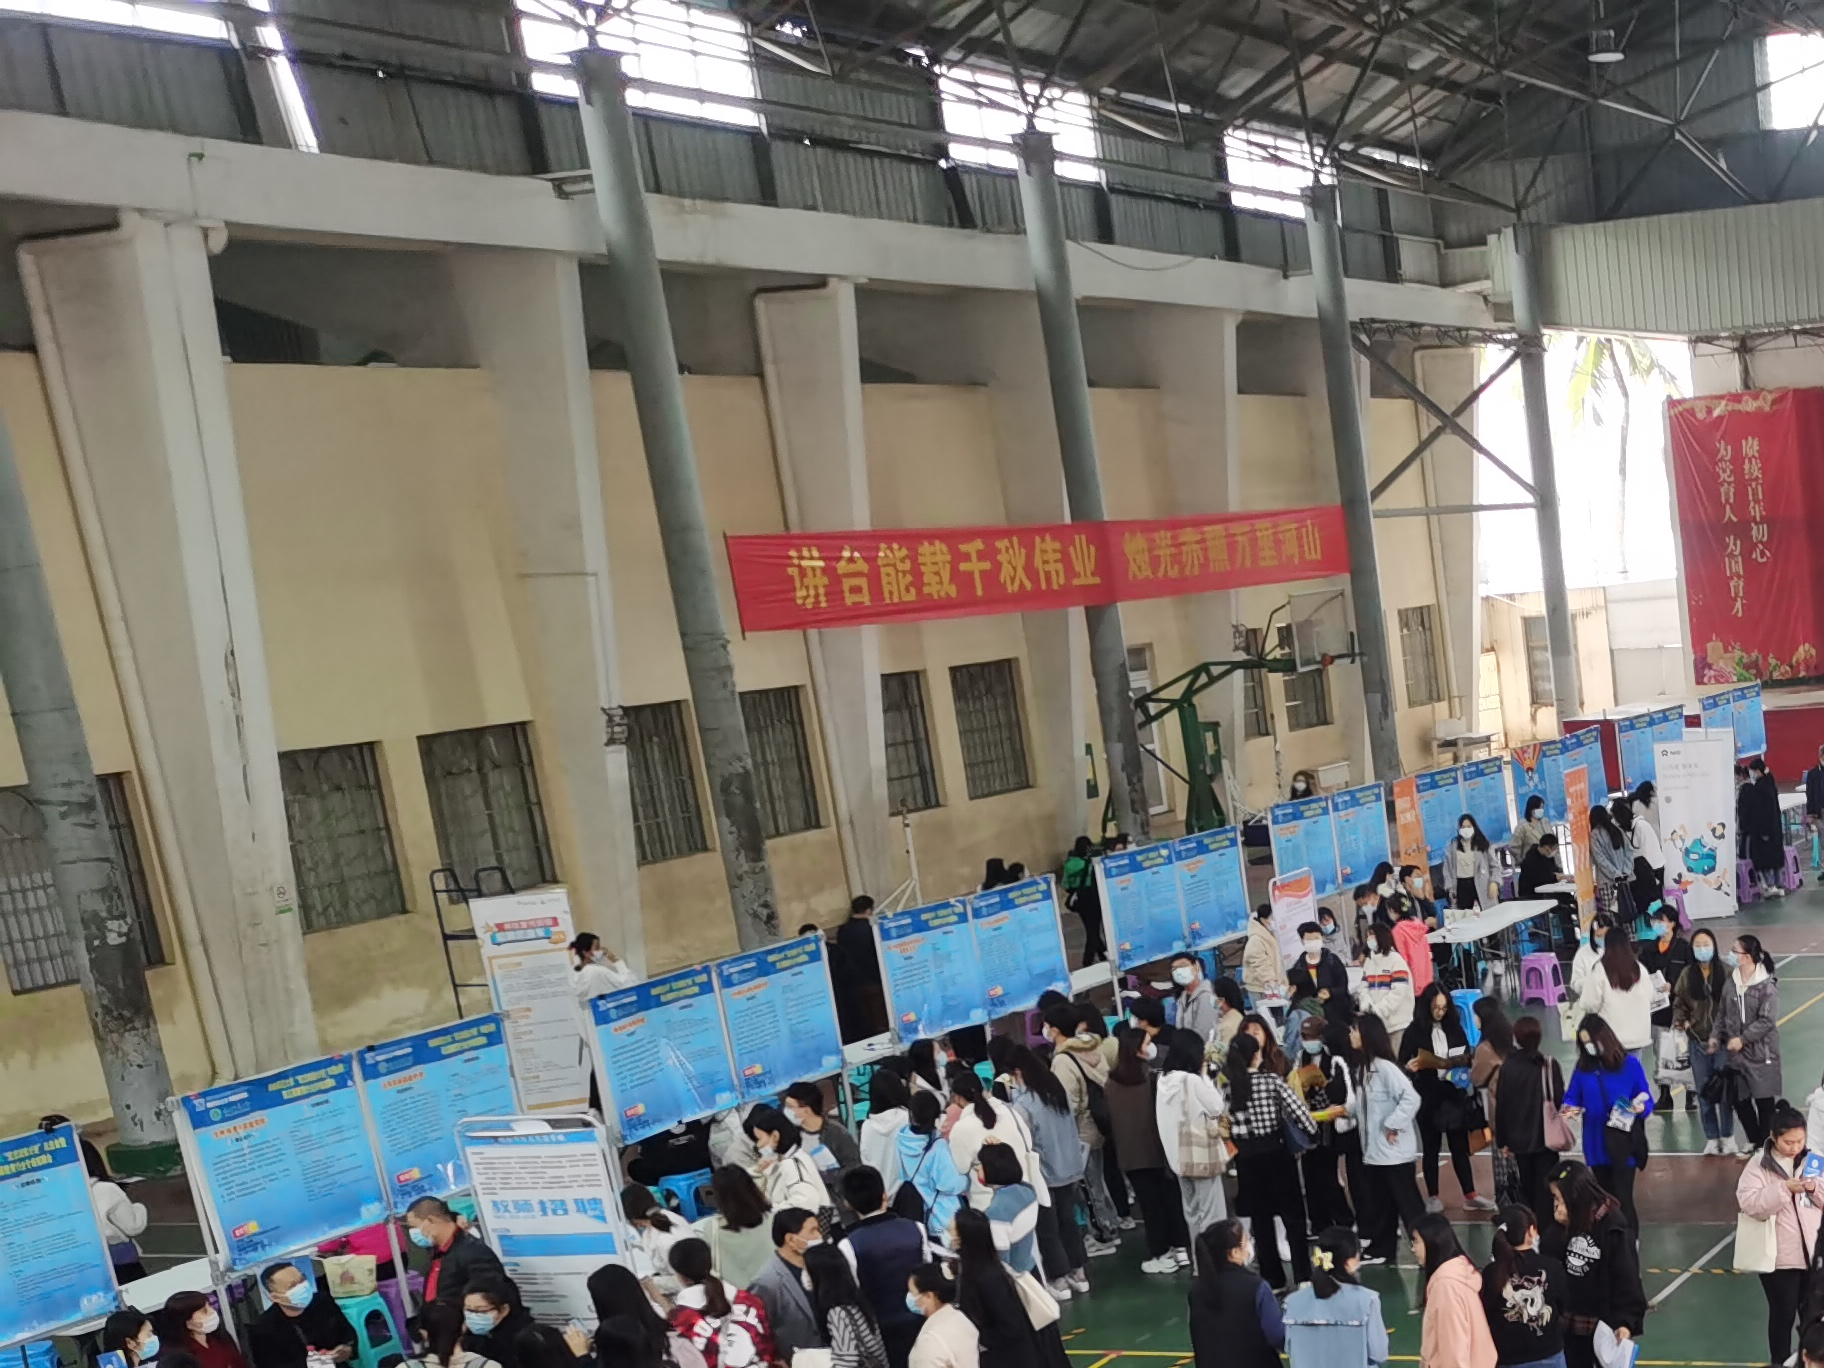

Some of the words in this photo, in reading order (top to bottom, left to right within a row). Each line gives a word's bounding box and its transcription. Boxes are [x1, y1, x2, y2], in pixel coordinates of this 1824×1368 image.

[1715, 439, 1738, 524] 为党育人
[786, 533, 1102, 609] 讲台能载千秋伟业
[1724, 535, 1748, 618] 为国育才
